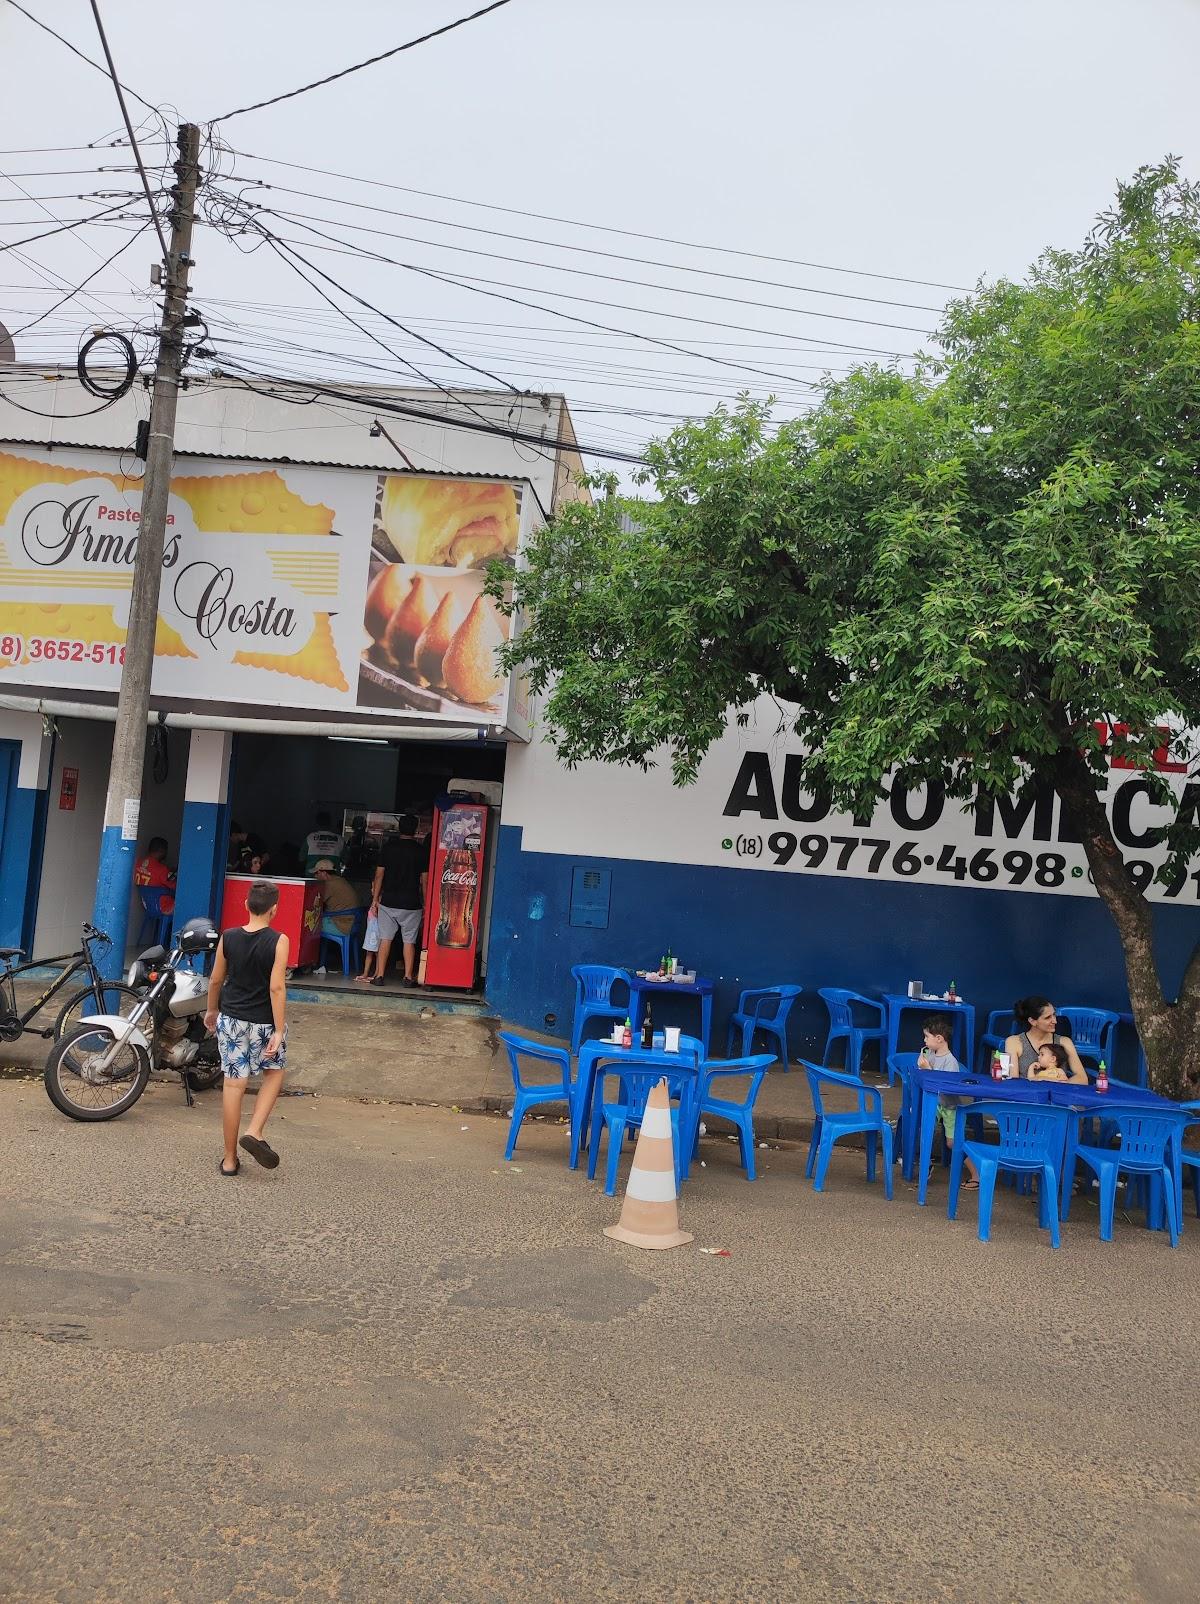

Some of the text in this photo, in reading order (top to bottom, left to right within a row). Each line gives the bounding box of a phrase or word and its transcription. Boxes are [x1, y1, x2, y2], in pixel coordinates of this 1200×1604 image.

[97, 505, 175, 525] Pastea
[21, 495, 182, 569] Irms
[173, 561, 297, 651] Costa
[29, 639, 128, 665] 3652-518
[722, 750, 945, 832] AUO
[736, 833, 763, 859] (18)
[441, 868, 478, 886] Coca-Cola
